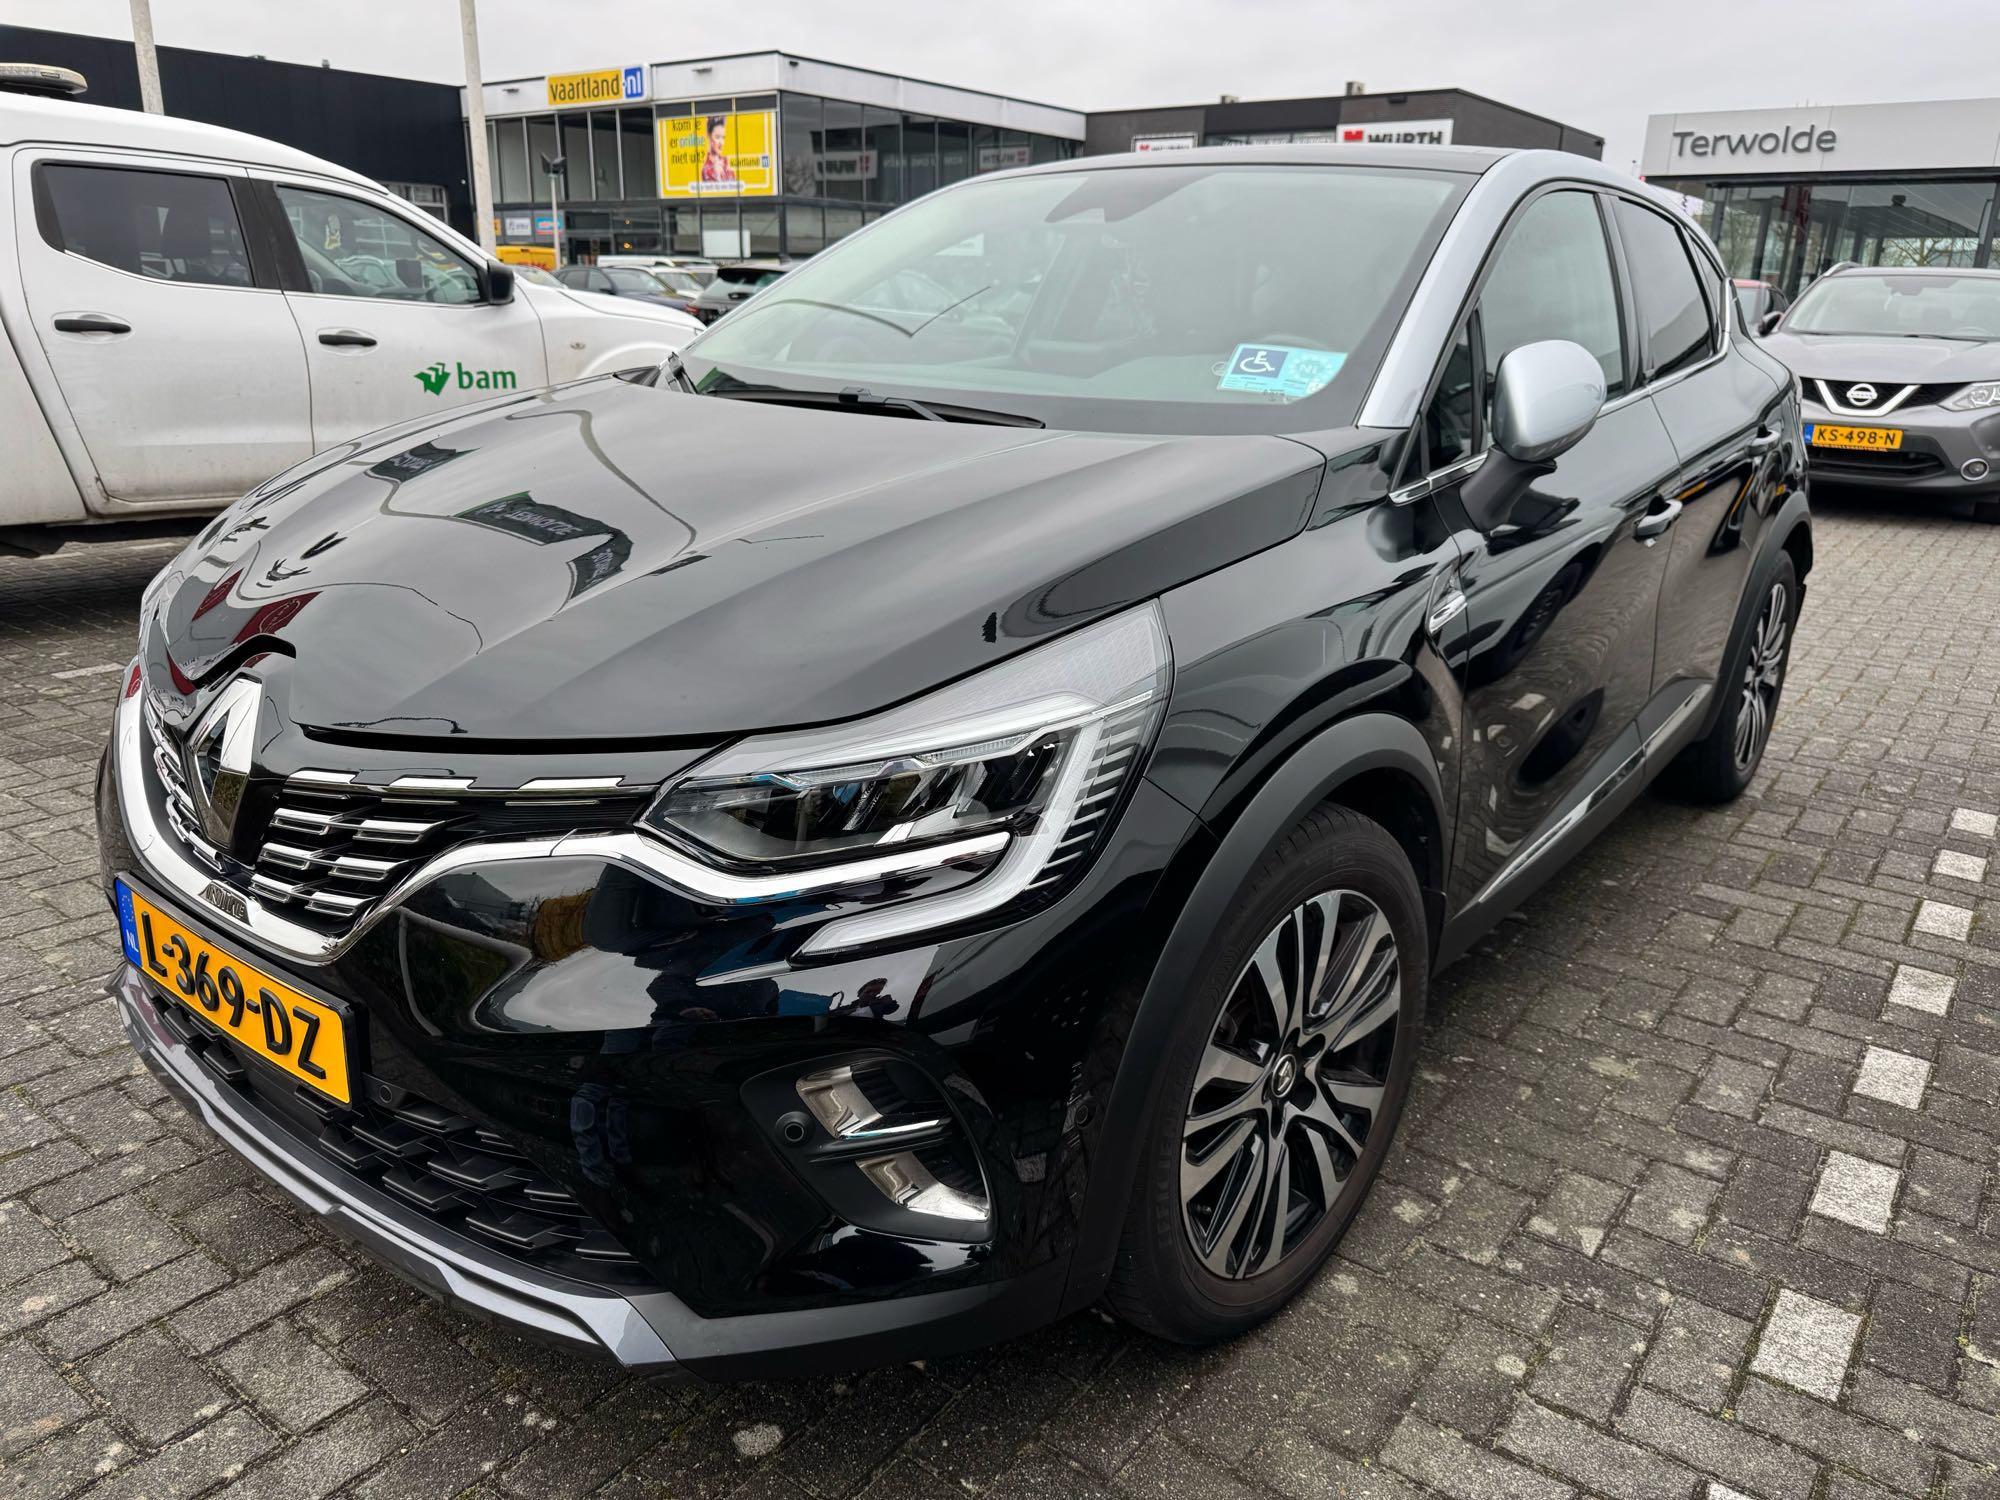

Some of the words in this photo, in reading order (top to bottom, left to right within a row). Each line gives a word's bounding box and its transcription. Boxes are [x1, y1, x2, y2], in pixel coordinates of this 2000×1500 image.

[671, 119, 691, 131] kom
[1672, 124, 1837, 157] Terwolde
[456, 362, 517, 389] bam
[1817, 428, 1896, 446] KS-498-N
[126, 928, 139, 953] NL
[141, 911, 326, 1080] L-369-DZ
